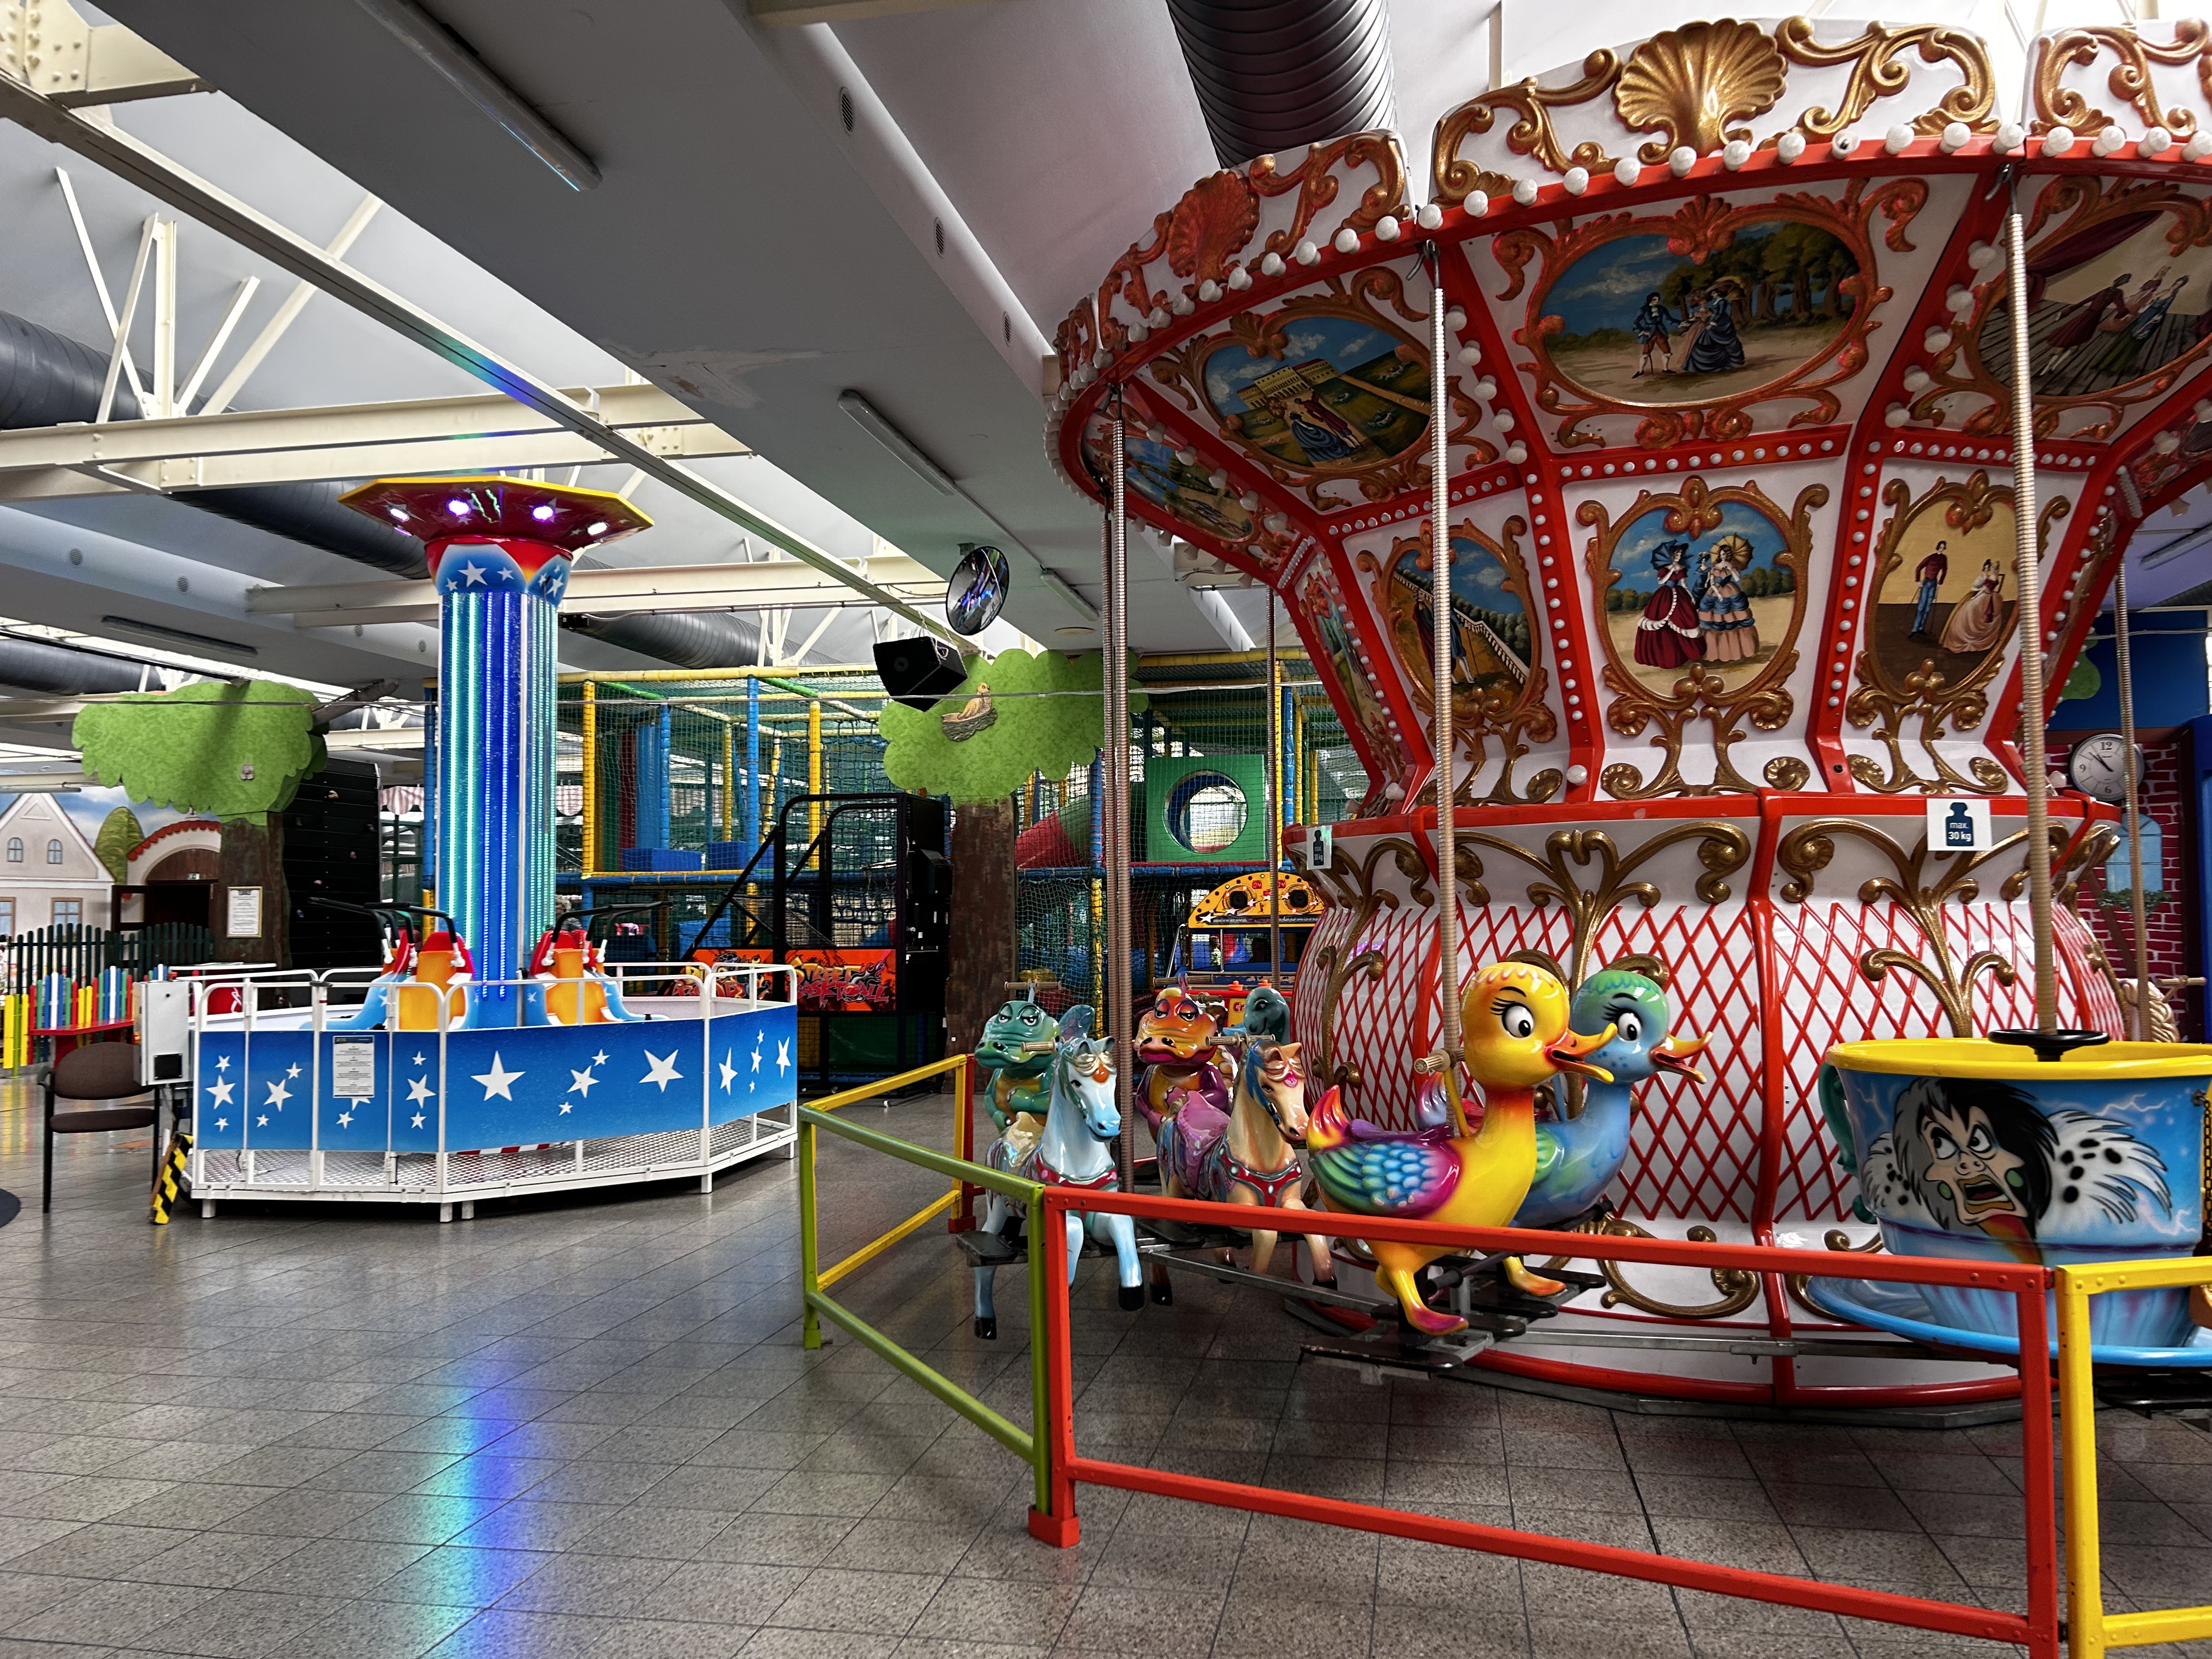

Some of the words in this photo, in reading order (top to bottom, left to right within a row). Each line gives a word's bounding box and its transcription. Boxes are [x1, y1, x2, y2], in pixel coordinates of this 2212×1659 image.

[2100, 741, 2113, 751] 12
[2079, 764, 2087, 773] 9
[2104, 786, 2112, 794] 6
[1948, 831, 1960, 840] 30
[1960, 831, 1972, 842] kg
